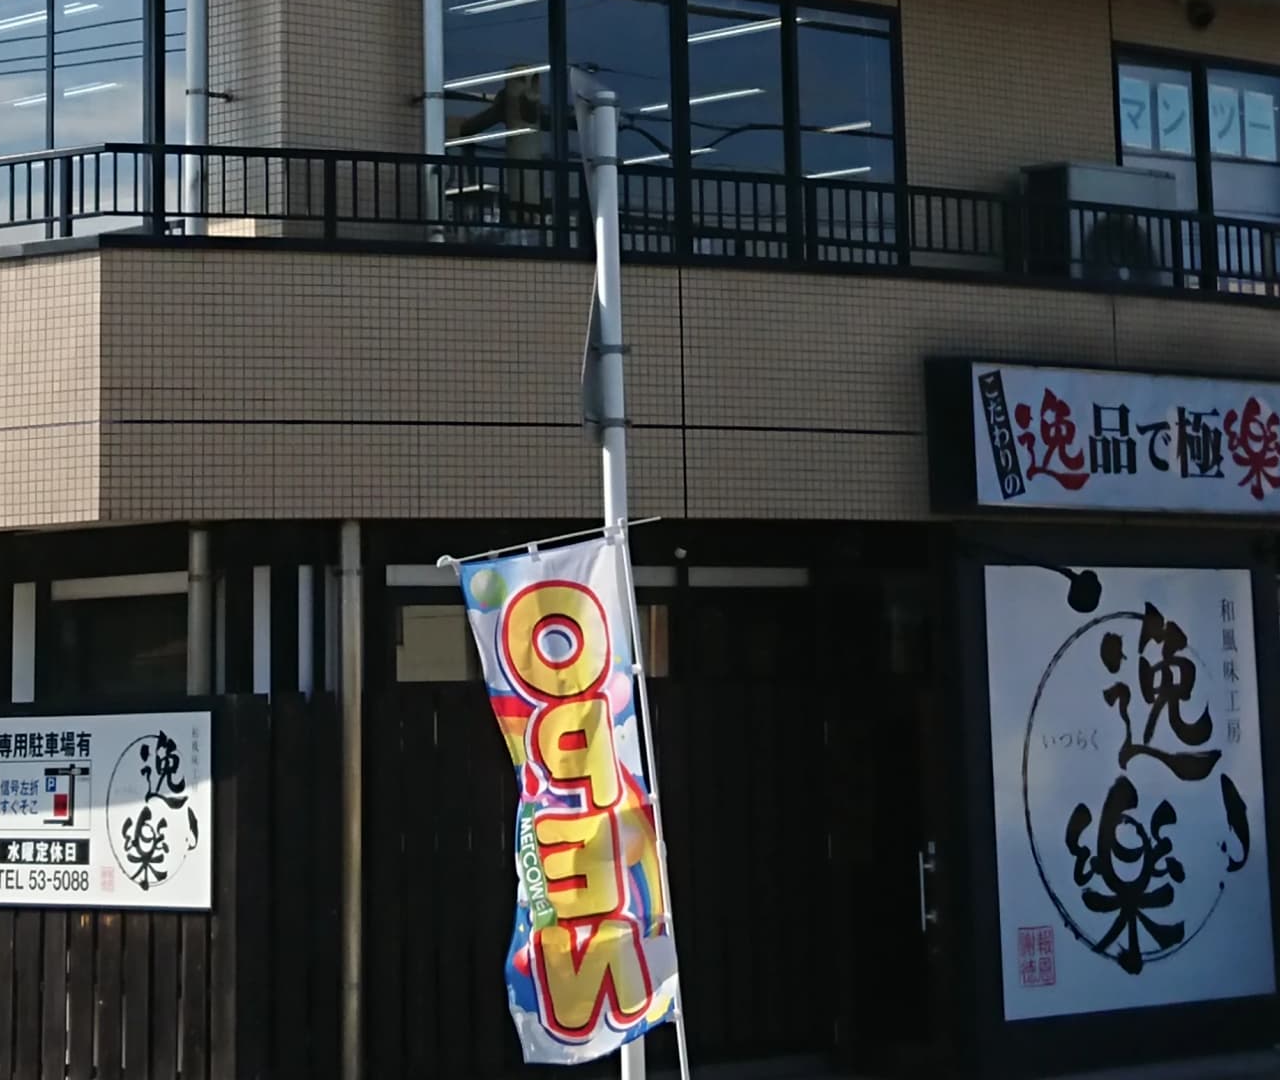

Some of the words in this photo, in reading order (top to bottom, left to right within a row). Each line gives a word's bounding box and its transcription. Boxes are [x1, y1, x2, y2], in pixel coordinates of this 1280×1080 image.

[7, 842, 77, 863] 水曜定休日
[28, 869, 90, 891] 53-5088
